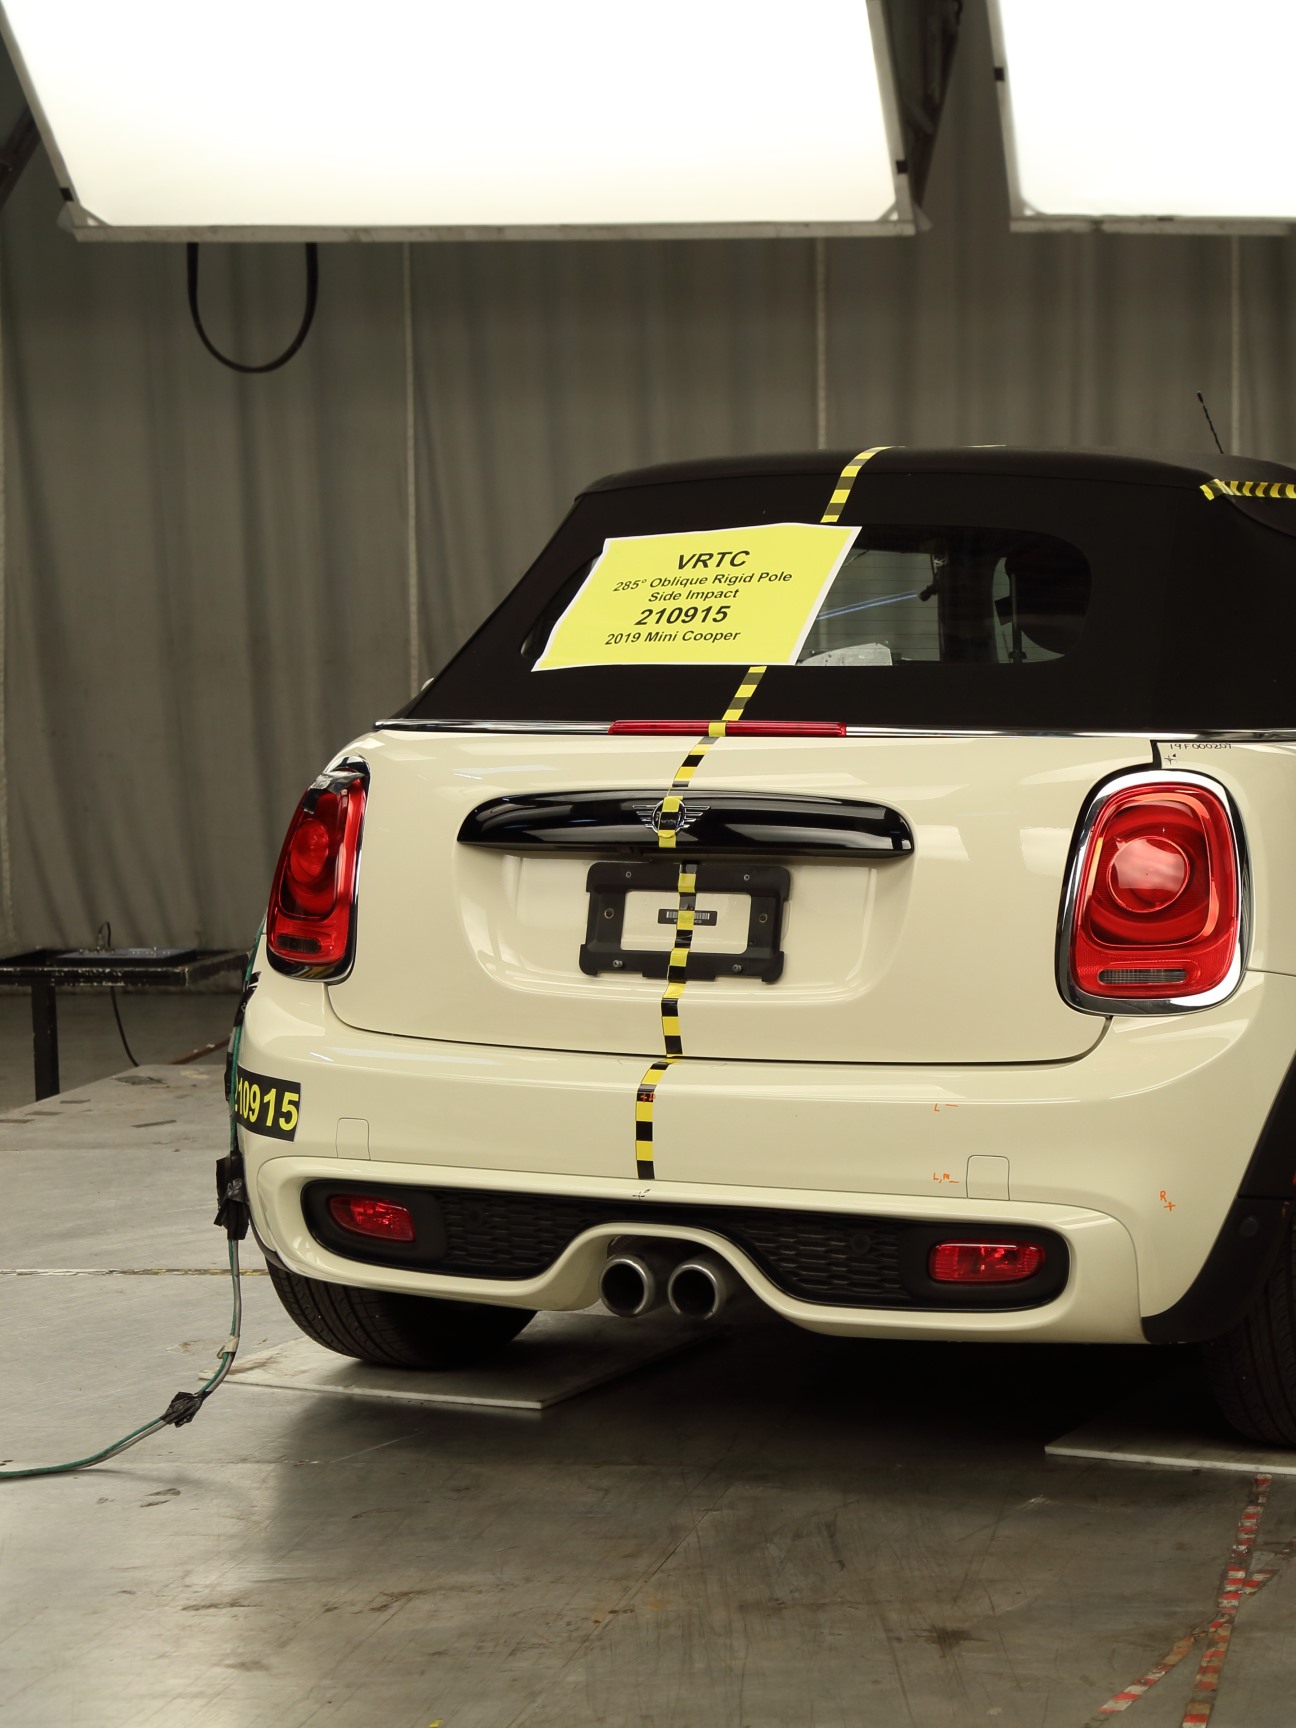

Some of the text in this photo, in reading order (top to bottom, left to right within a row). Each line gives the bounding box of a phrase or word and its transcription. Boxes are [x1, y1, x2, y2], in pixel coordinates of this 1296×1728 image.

[677, 550, 750, 570] VRTC
[649, 575, 708, 588] Oblique
[712, 572, 755, 586] Rigid
[757, 571, 793, 583] Pole
[648, 588, 740, 602] Side Impact
[633, 605, 731, 626] 210915
[604, 630, 741, 645] 2019 Mini Cooper
[235, 1074, 299, 1131] 10915
